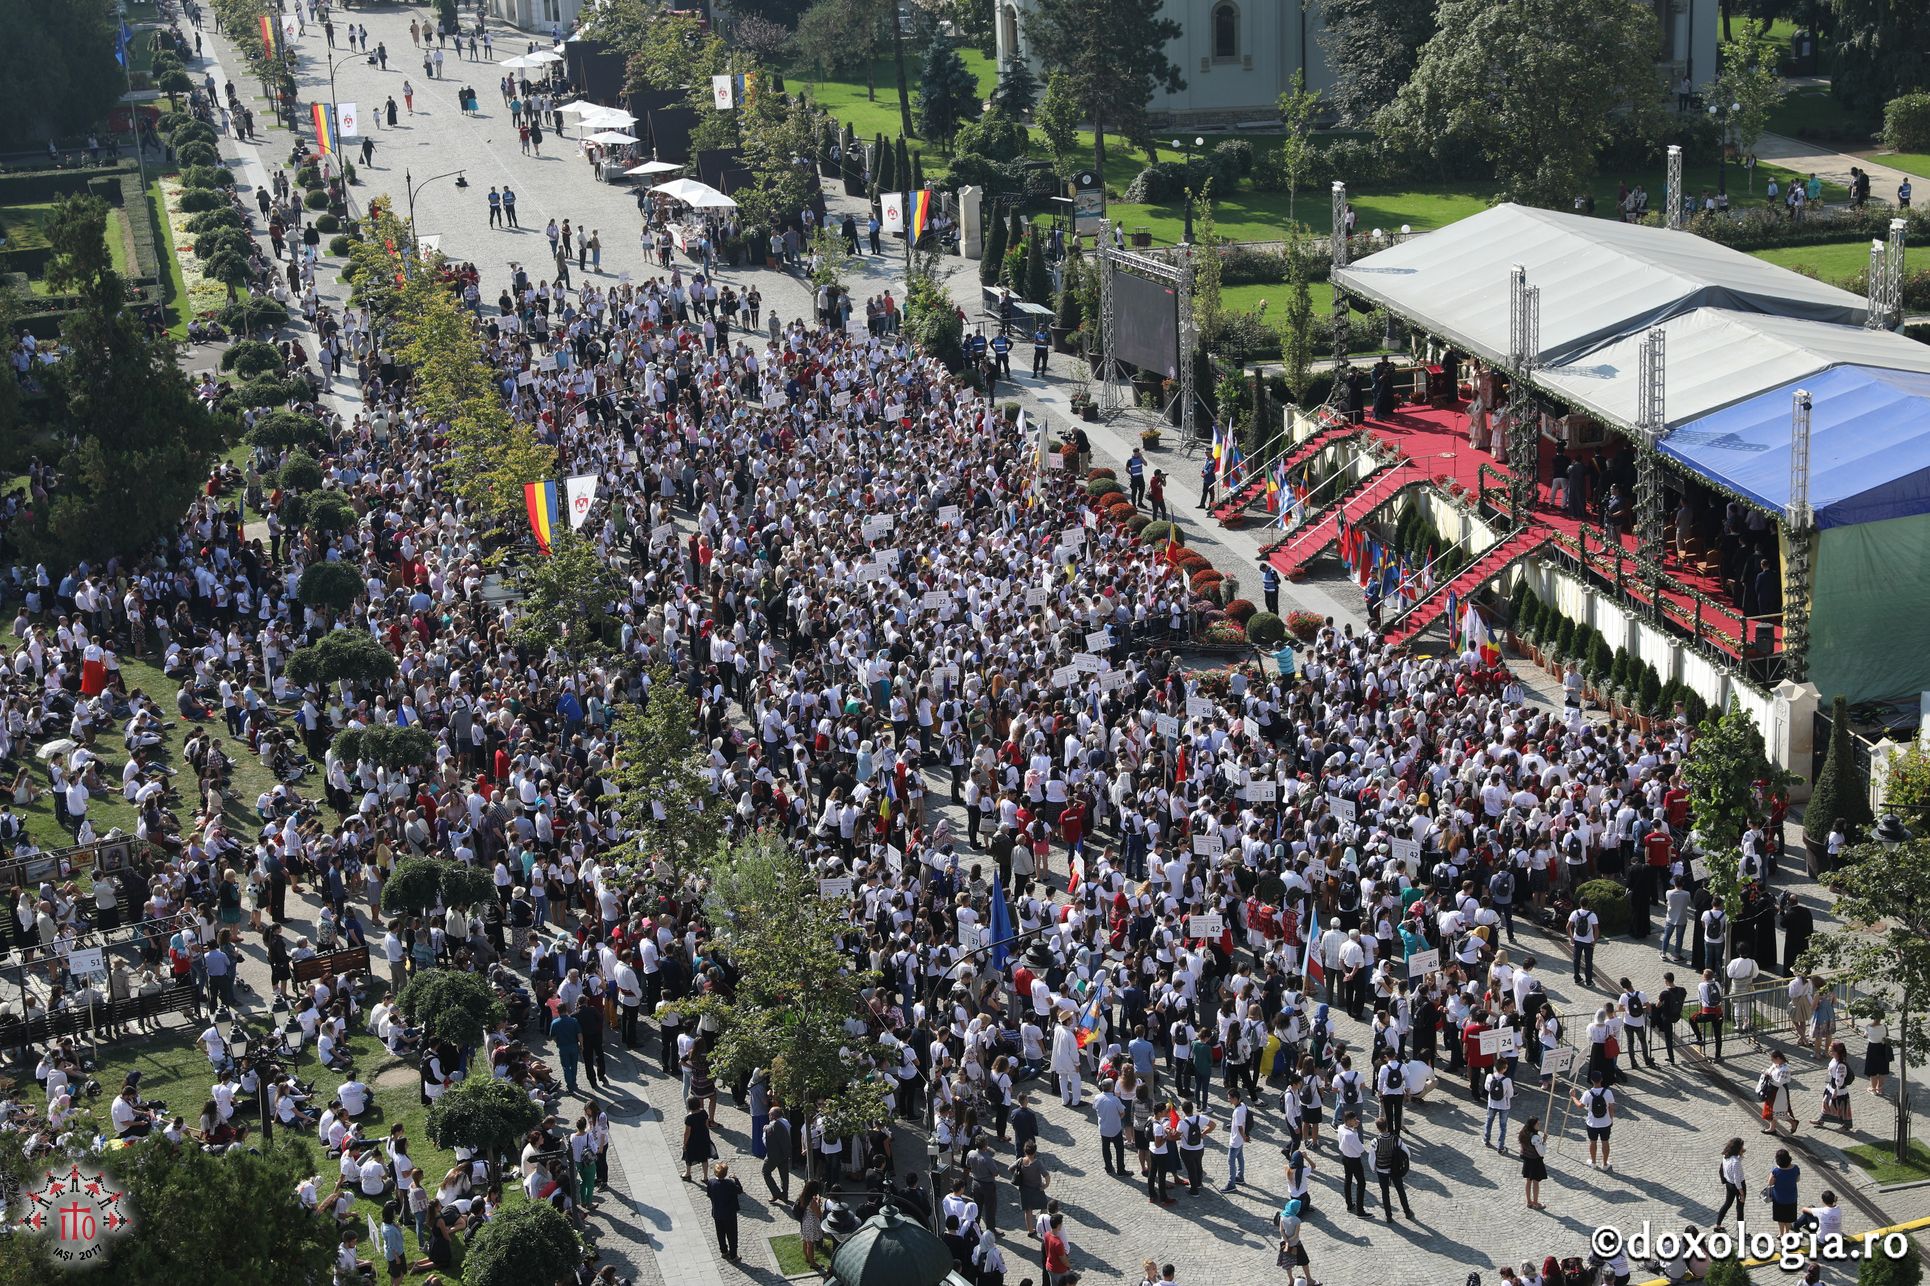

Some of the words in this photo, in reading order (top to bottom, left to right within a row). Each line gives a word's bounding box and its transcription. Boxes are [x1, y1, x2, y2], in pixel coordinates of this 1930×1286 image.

[90, 959, 100, 967] 51
[1502, 1038, 1512, 1047] 24
[1559, 1059, 1569, 1067] 24
